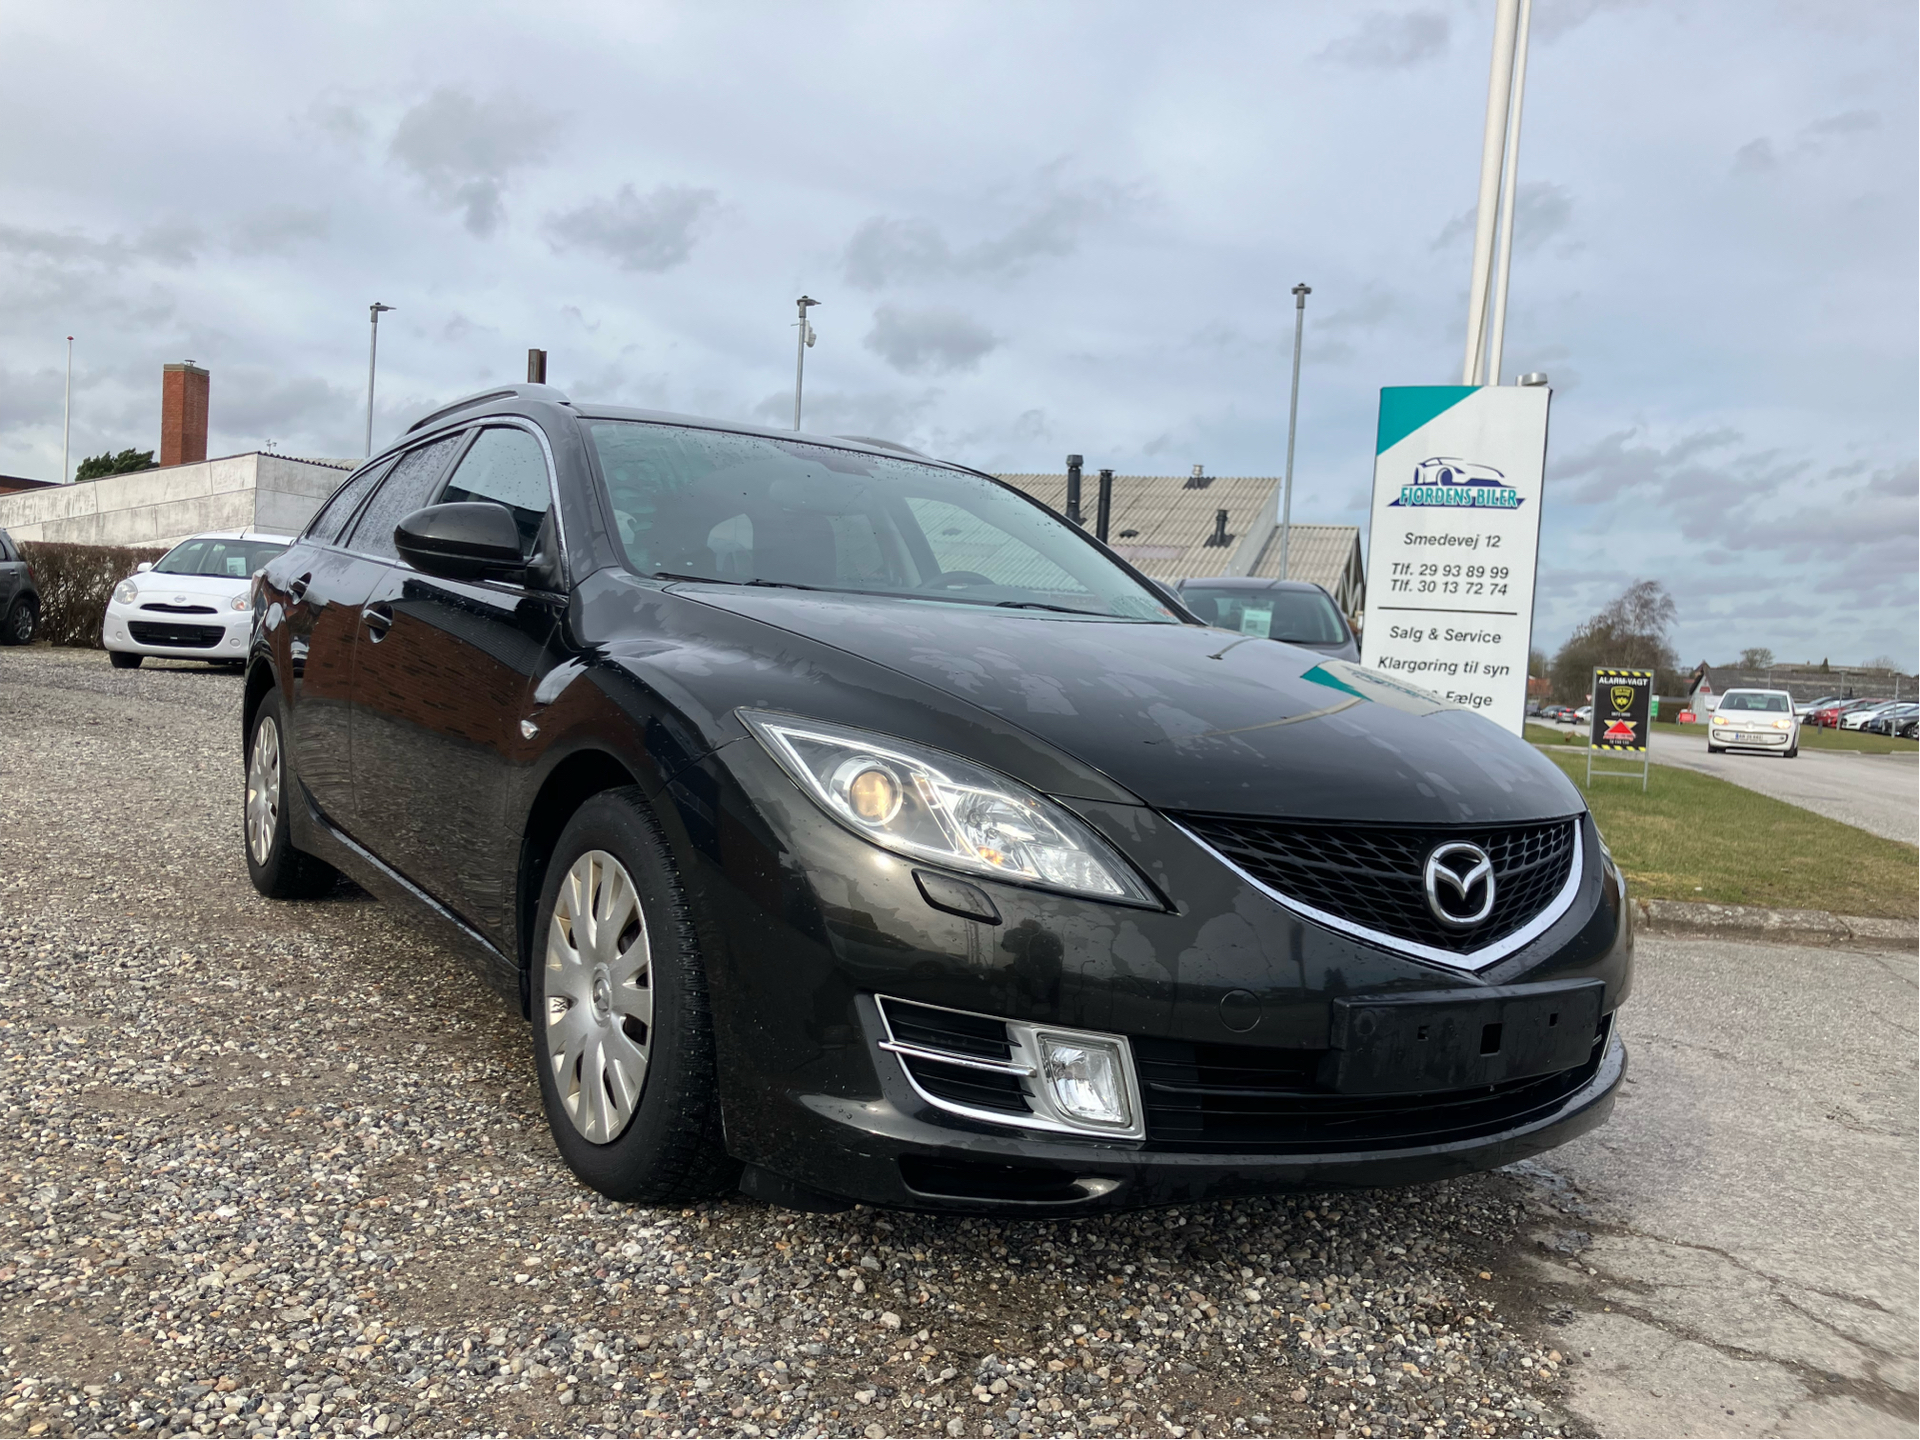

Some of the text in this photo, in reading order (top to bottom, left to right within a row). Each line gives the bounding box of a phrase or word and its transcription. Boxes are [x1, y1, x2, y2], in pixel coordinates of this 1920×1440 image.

[1400, 487, 1518, 507] FJORDENS BILER
[1404, 532, 1501, 550] Smedevej 12
[1392, 562, 1509, 579] Tlf. 29 93 89 99
[1391, 579, 1508, 596] Tlf. 30 13 72 74
[1389, 626, 1502, 644] Salg & Service
[1378, 656, 1510, 678] Klargøring til syn
[1598, 676, 1649, 687] ALARM-VAGT
